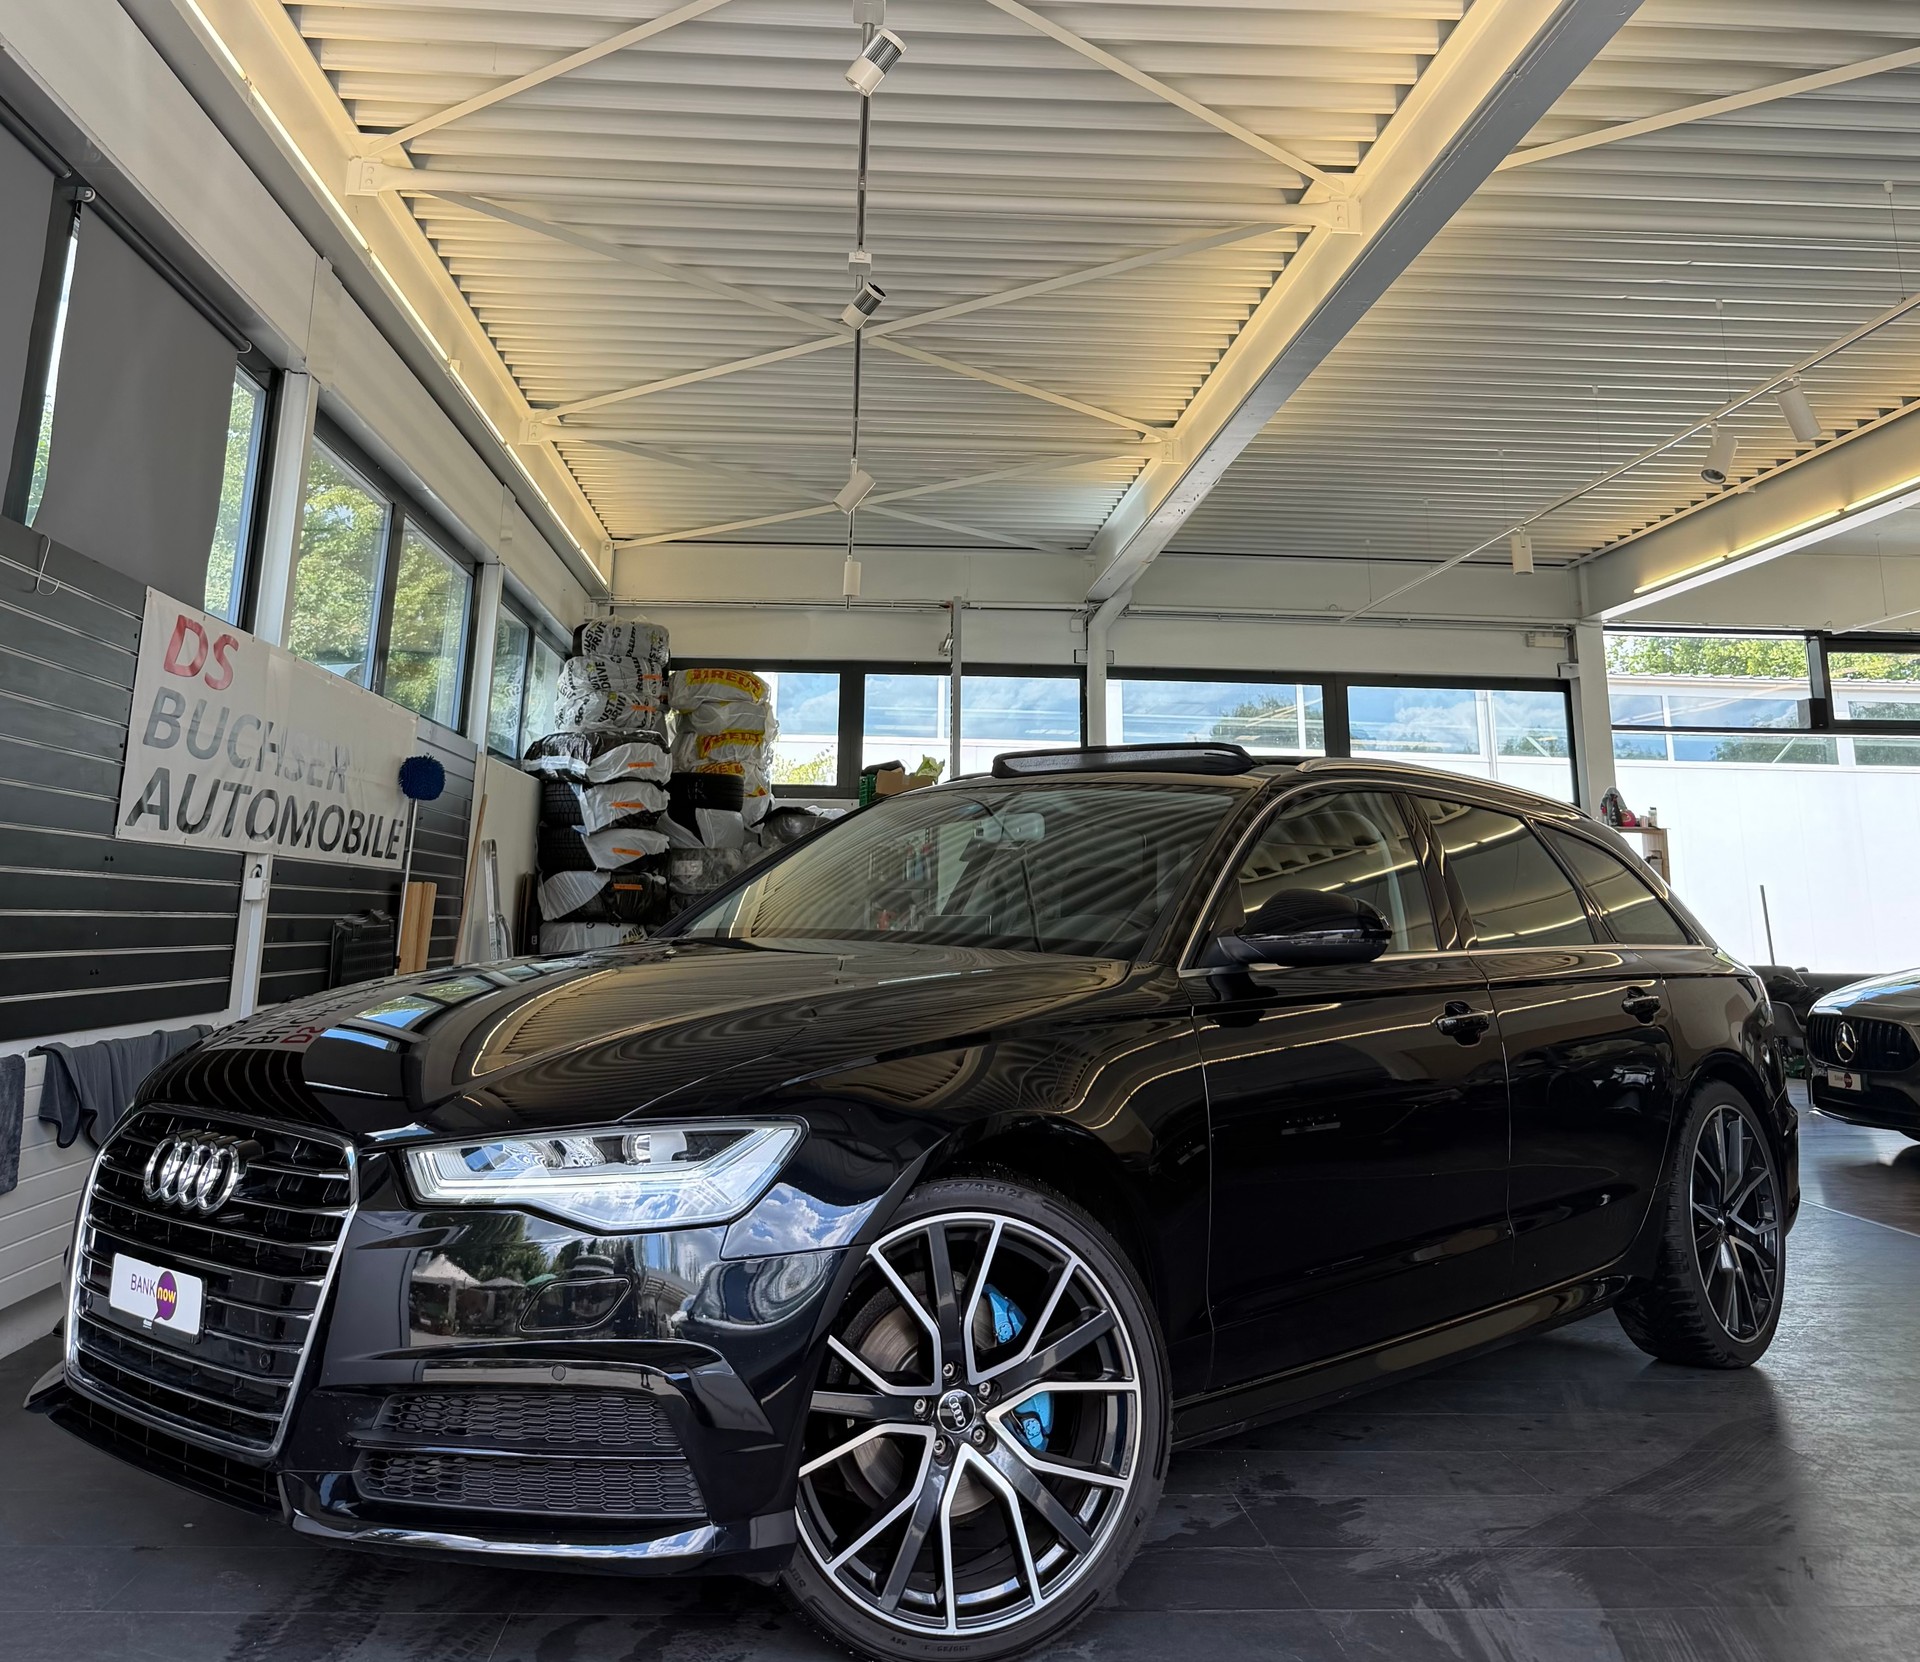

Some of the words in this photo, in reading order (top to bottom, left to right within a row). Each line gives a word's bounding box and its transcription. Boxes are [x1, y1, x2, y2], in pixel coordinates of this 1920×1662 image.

[163, 614, 240, 691] DS
[125, 766, 404, 861] AUTOMOBILE
[130, 1273, 156, 1298] BANK
[157, 1286, 178, 1304] now
